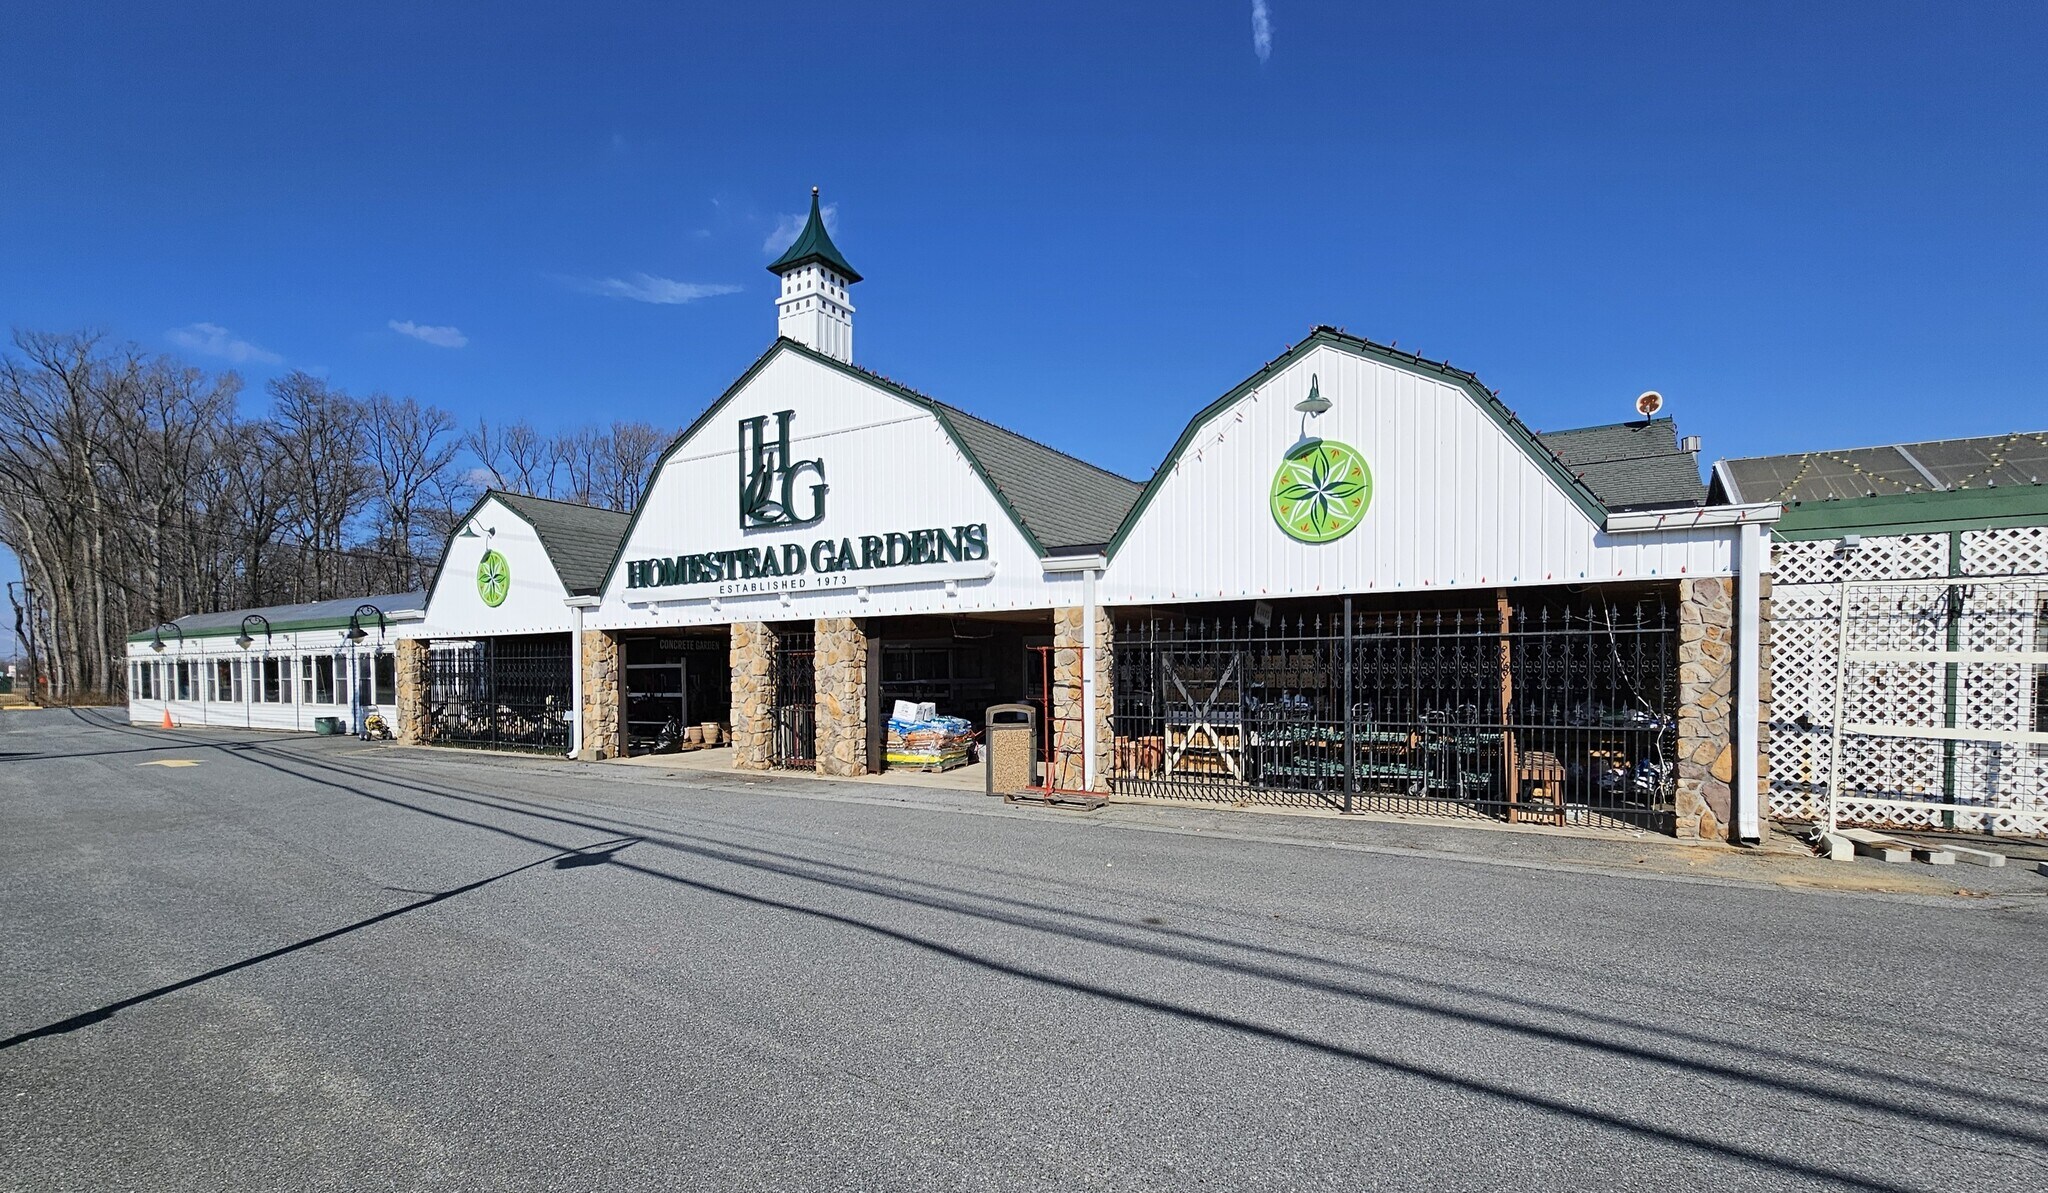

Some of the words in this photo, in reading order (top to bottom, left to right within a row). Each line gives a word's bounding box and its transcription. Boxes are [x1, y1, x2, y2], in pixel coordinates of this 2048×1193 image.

[625, 543, 807, 589] HOMESTEAD
[811, 523, 989, 574] GARDENS
[719, 579, 806, 594] ESTABLISHED
[817, 575, 847, 587] 1973
[660, 639, 694, 650] CONCRETE
[695, 640, 720, 650] GARDEN
